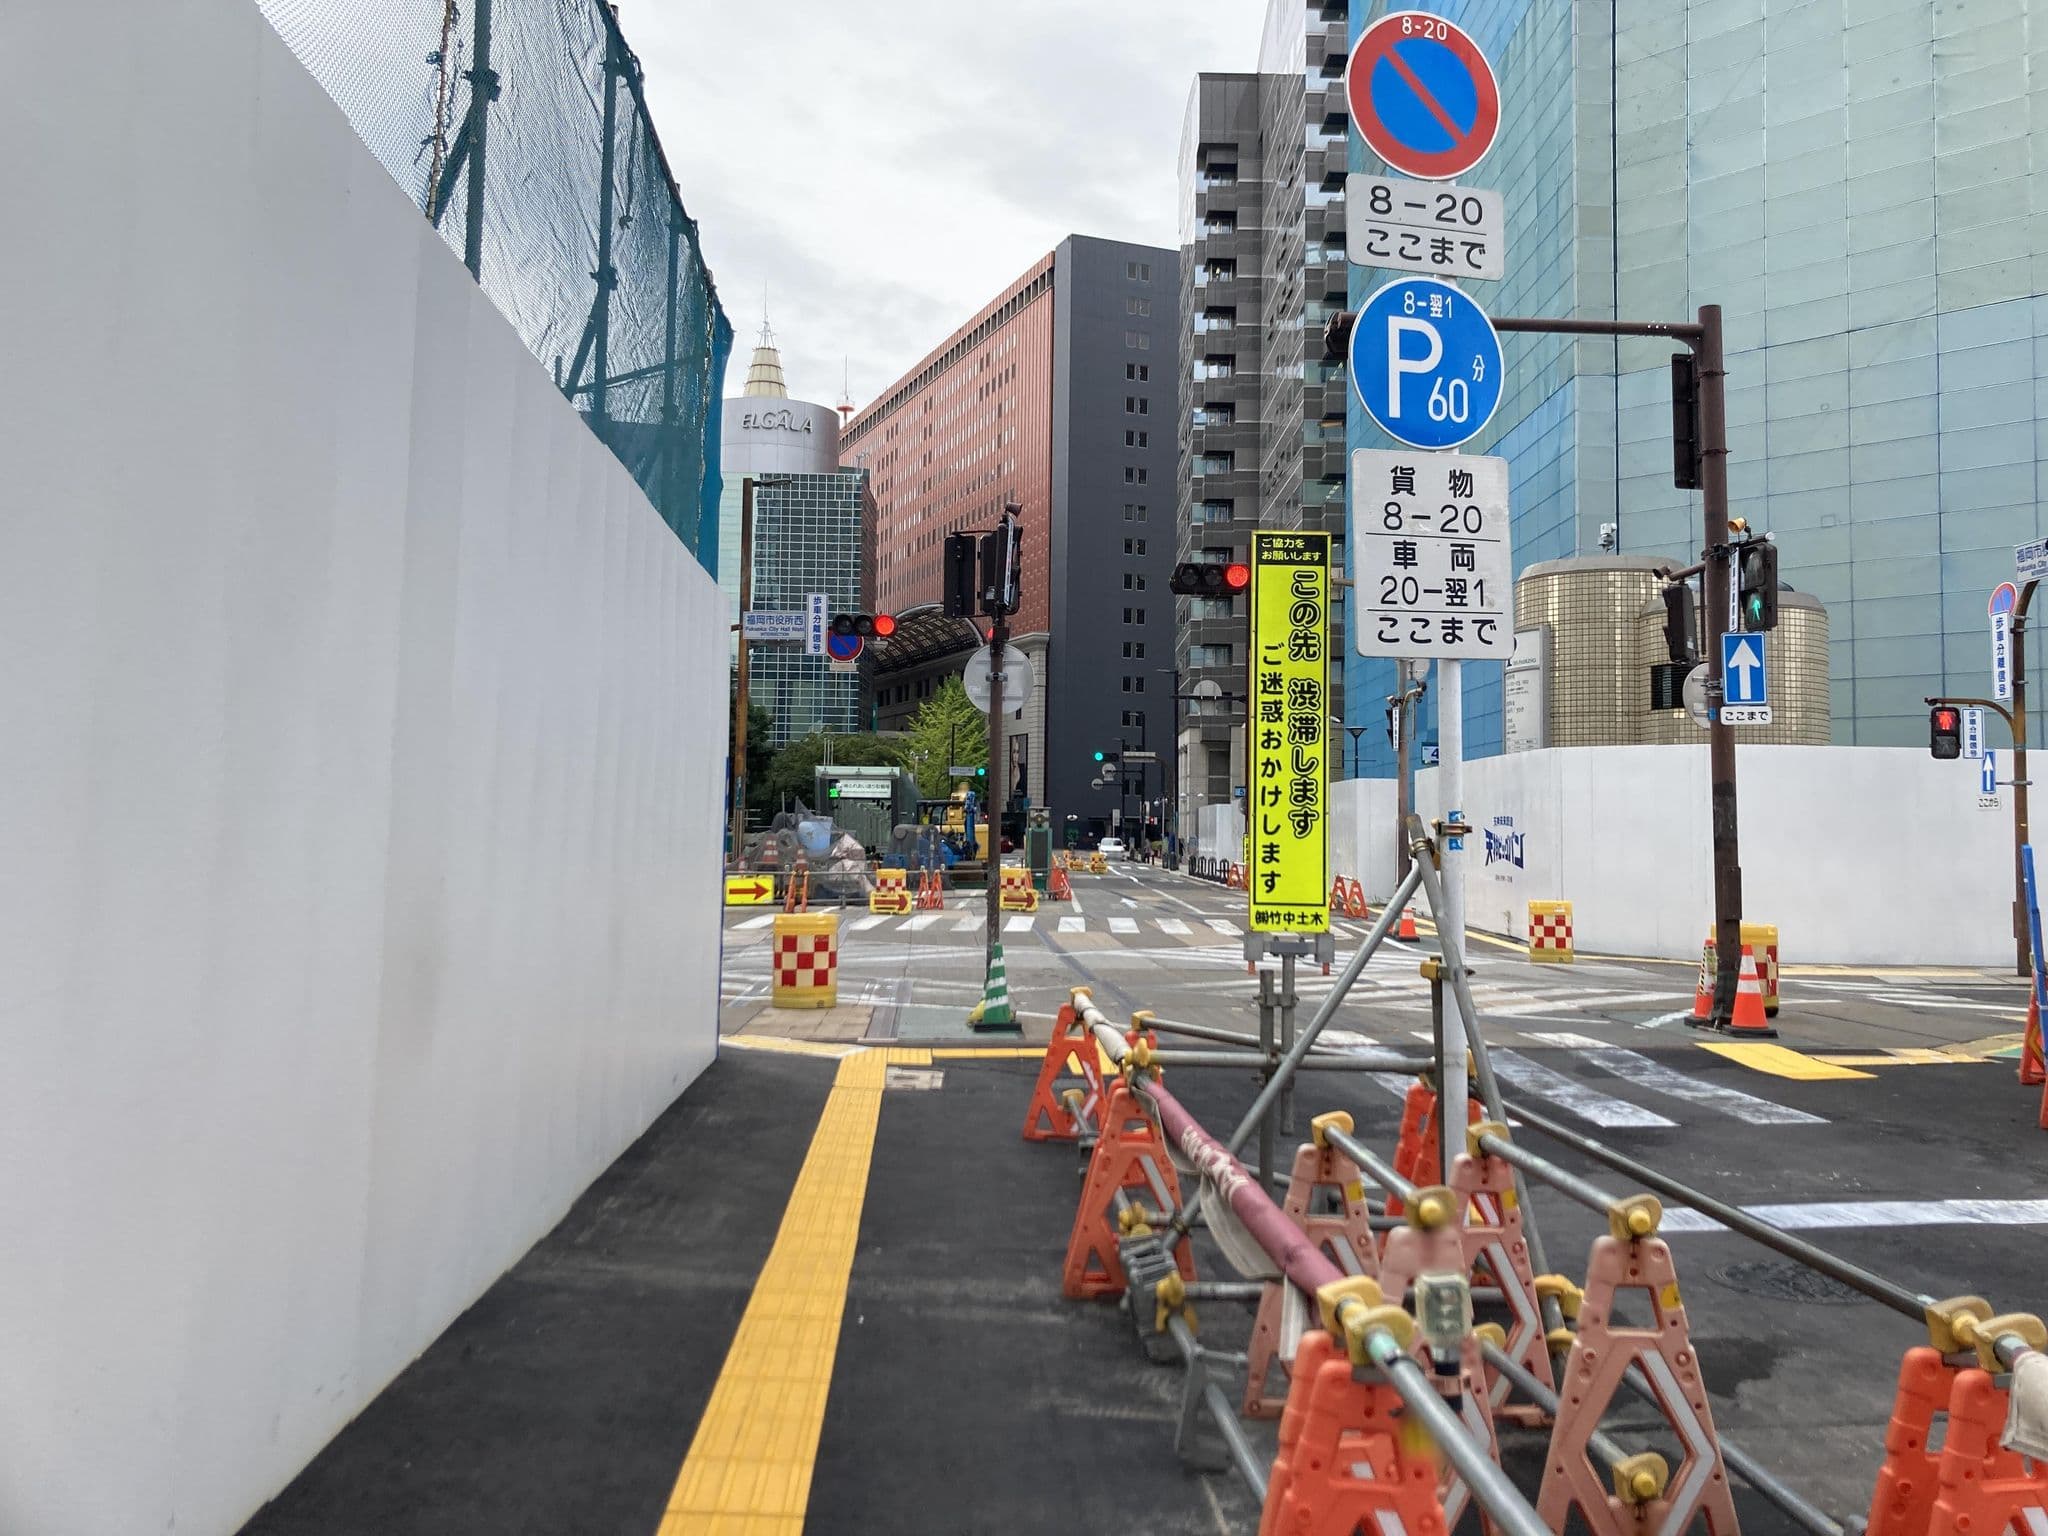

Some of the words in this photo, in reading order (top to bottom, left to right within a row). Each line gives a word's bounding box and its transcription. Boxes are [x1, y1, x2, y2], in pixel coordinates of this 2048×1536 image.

[1402, 16, 1448, 41] 8-20
[1369, 185, 1483, 226] 8-20
[1366, 228, 1486, 270] ここまで
[1403, 291, 1453, 319] 8-翌1
[1387, 315, 1443, 419] P
[1427, 376, 1469, 424] 60
[1471, 354, 1486, 382] 分
[1390, 465, 1474, 499] 貨物
[1383, 501, 1482, 534] 8-20
[1261, 538, 1305, 549] ご協力を
[1261, 551, 1322, 561] お願いします
[1392, 541, 1476, 573] 車両
[1380, 576, 1486, 608] 20-翌1
[746, 614, 804, 625] 福岡市役所西
[812, 595, 822, 653] 歩車分離信号
[1288, 570, 1321, 661] この先
[1377, 616, 1498, 646] ここまで
[1725, 711, 1769, 721] ここまで
[1260, 642, 1285, 894] ご迷惑おかけします
[1287, 678, 1321, 839] 渋滞します
